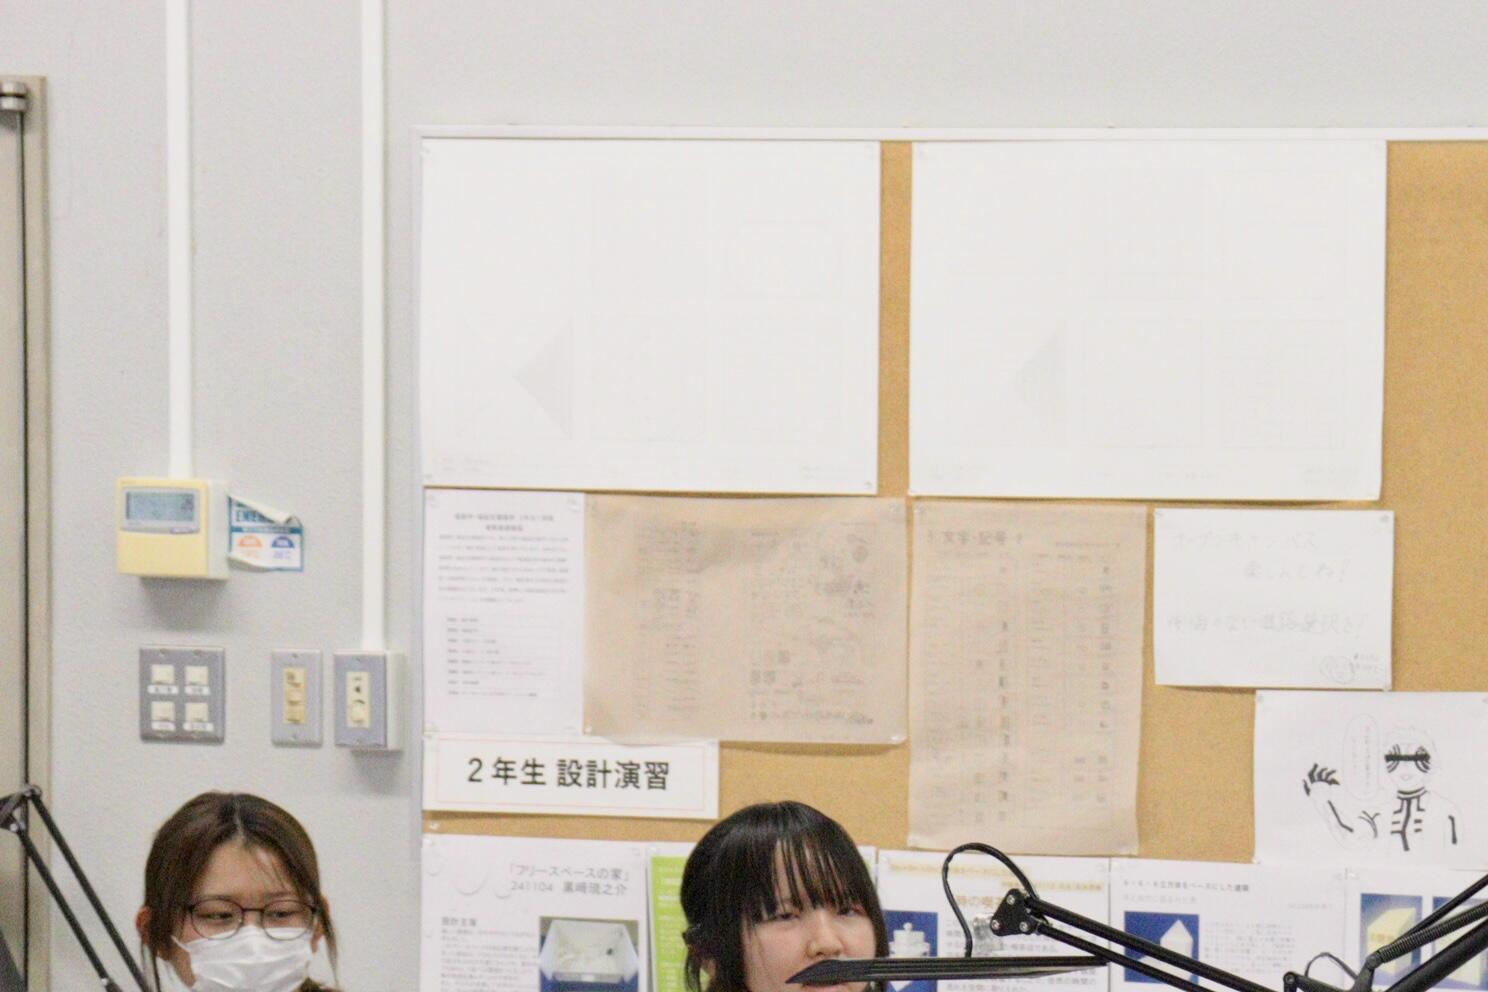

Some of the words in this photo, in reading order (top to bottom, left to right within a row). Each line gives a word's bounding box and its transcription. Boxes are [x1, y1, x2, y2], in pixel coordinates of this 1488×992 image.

[467, 757, 546, 786] 2年生
[556, 759, 670, 790] 設計演習
